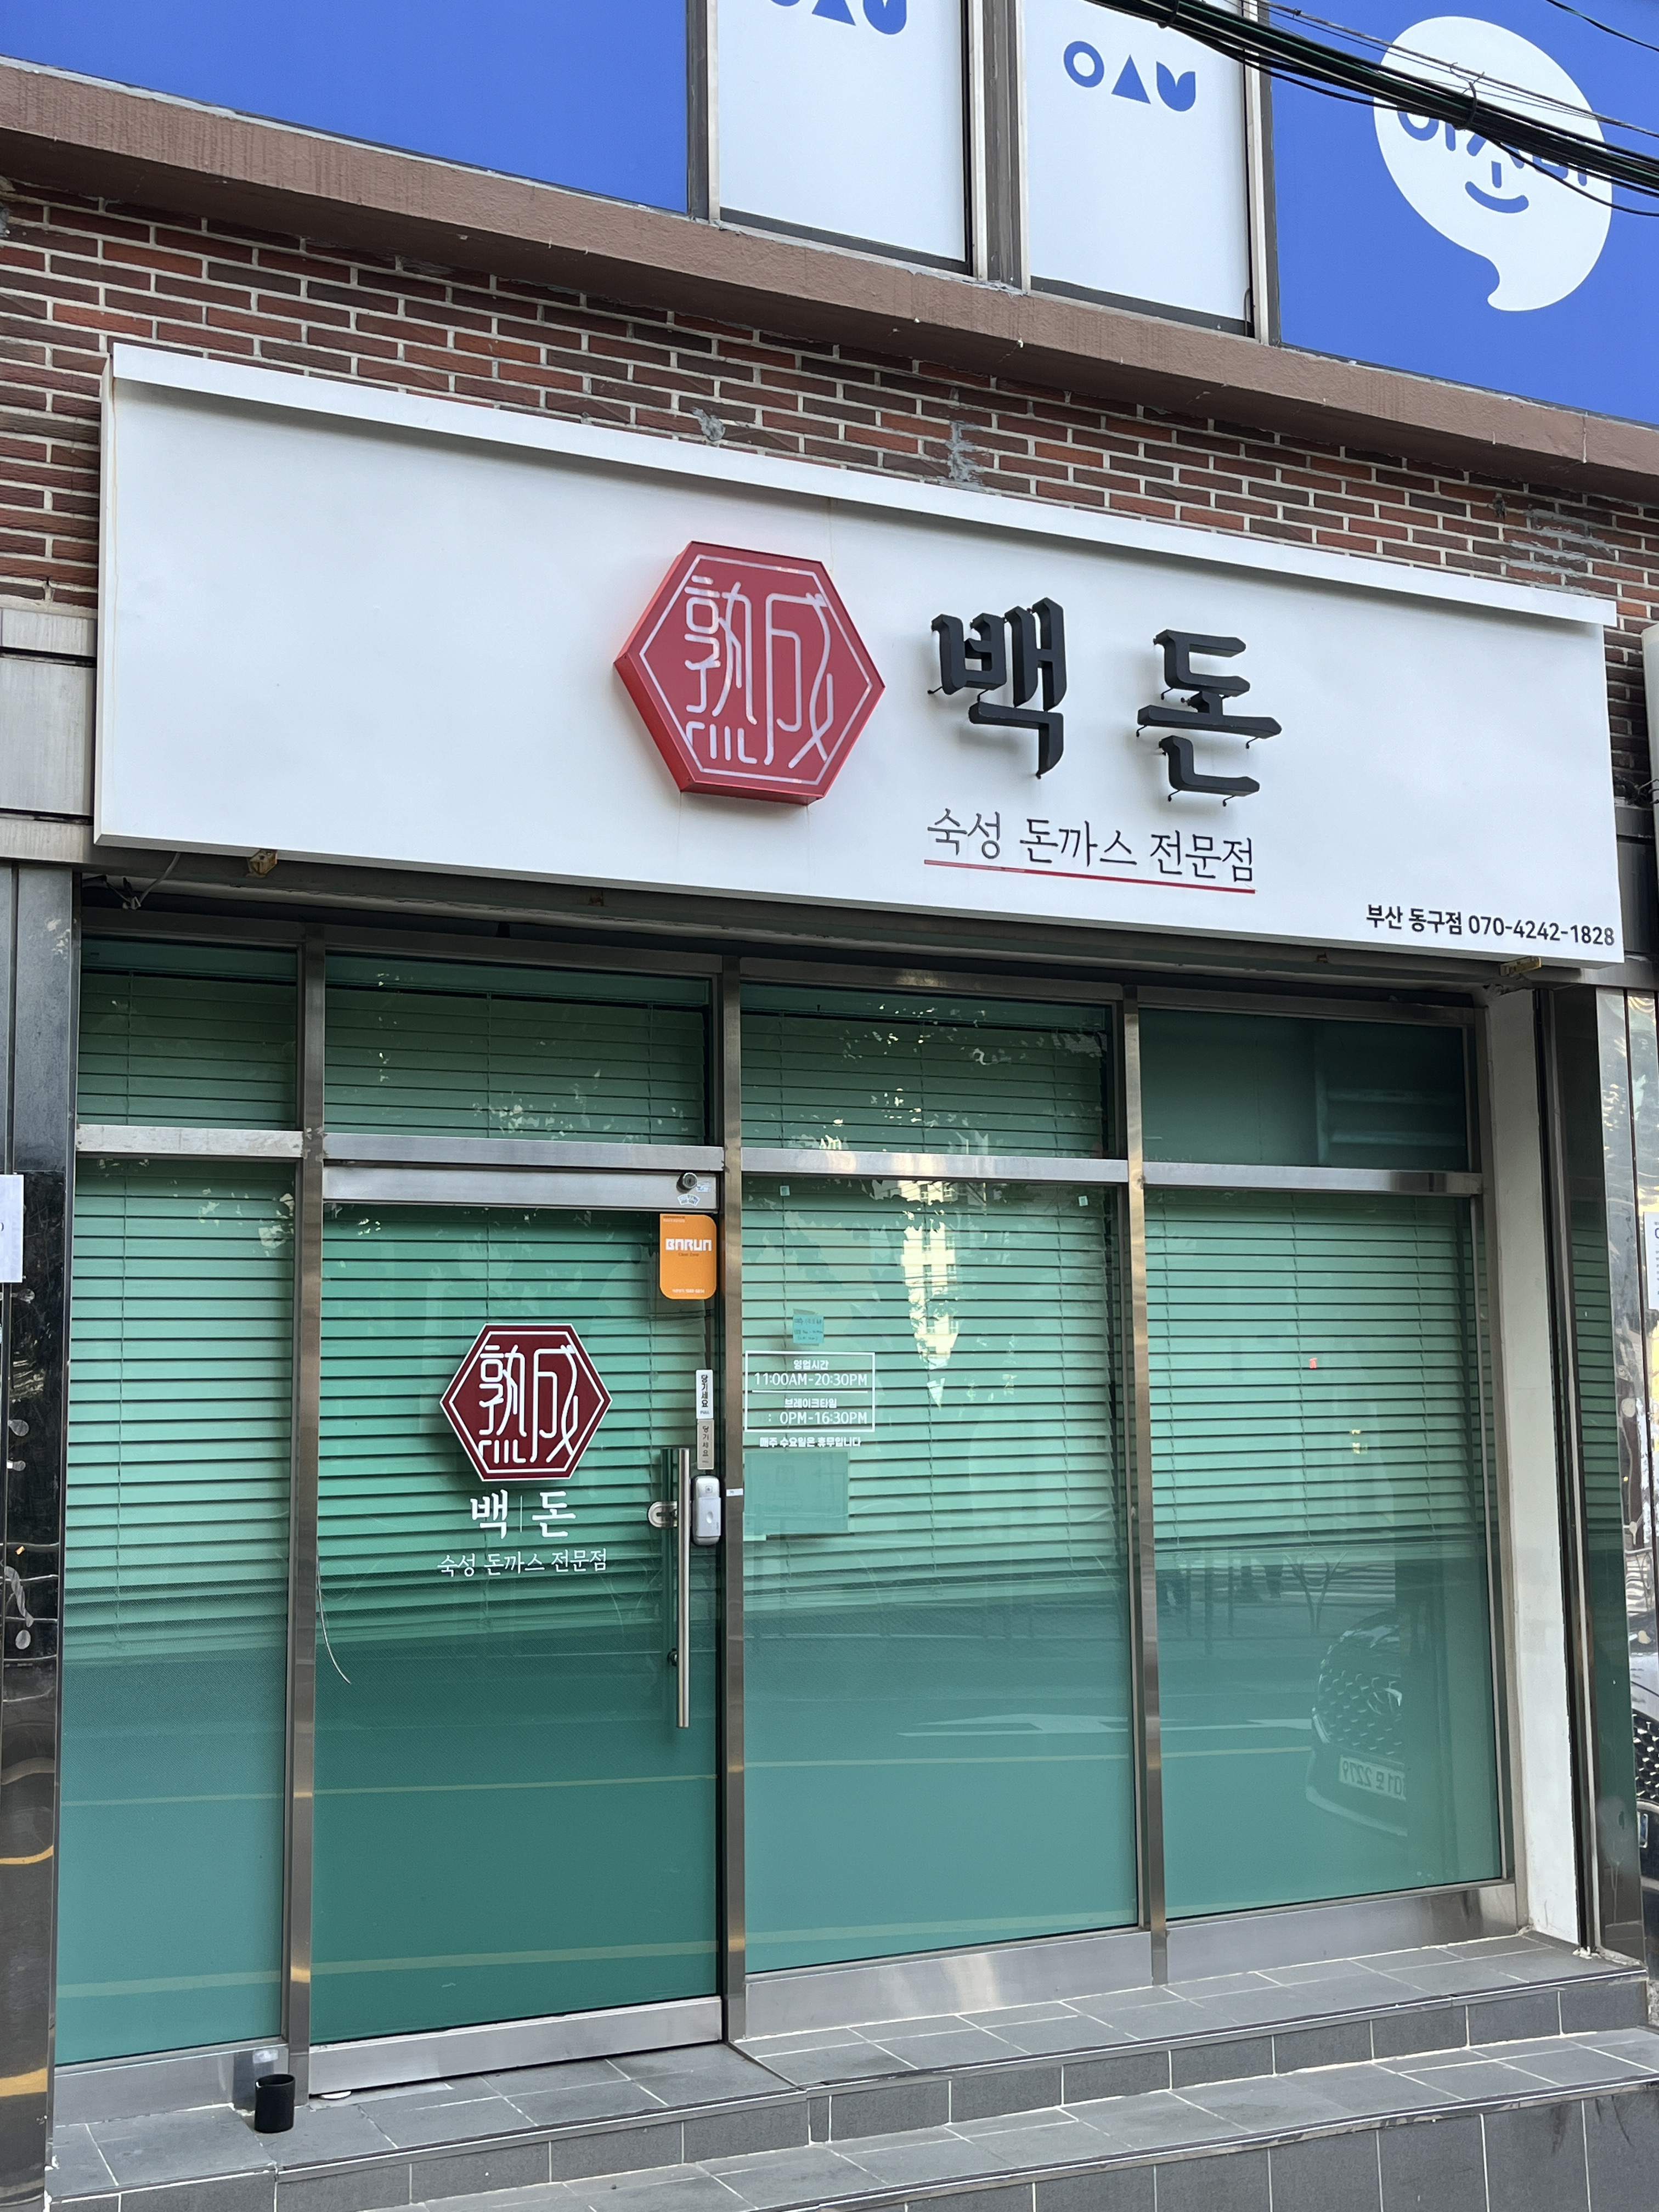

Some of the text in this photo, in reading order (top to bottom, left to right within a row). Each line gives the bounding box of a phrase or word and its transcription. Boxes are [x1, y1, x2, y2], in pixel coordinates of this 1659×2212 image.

[927, 808, 1252, 882] 숙성 돈까스 전문점
[1366, 904, 1615, 946] 부산 동구점 070-4242-1828
[793, 1359, 830, 1371] 영업시간
[754, 1373, 868, 1386] 11:00AM-20:30PM
[701, 1374, 709, 1408] 당기세요
[785, 1398, 837, 1409] 브레이크타임
[759, 1436, 861, 1448] 매주 수요일은 휴무입니다
[437, 1548, 607, 1577] 숙성 돈까스 전문점
